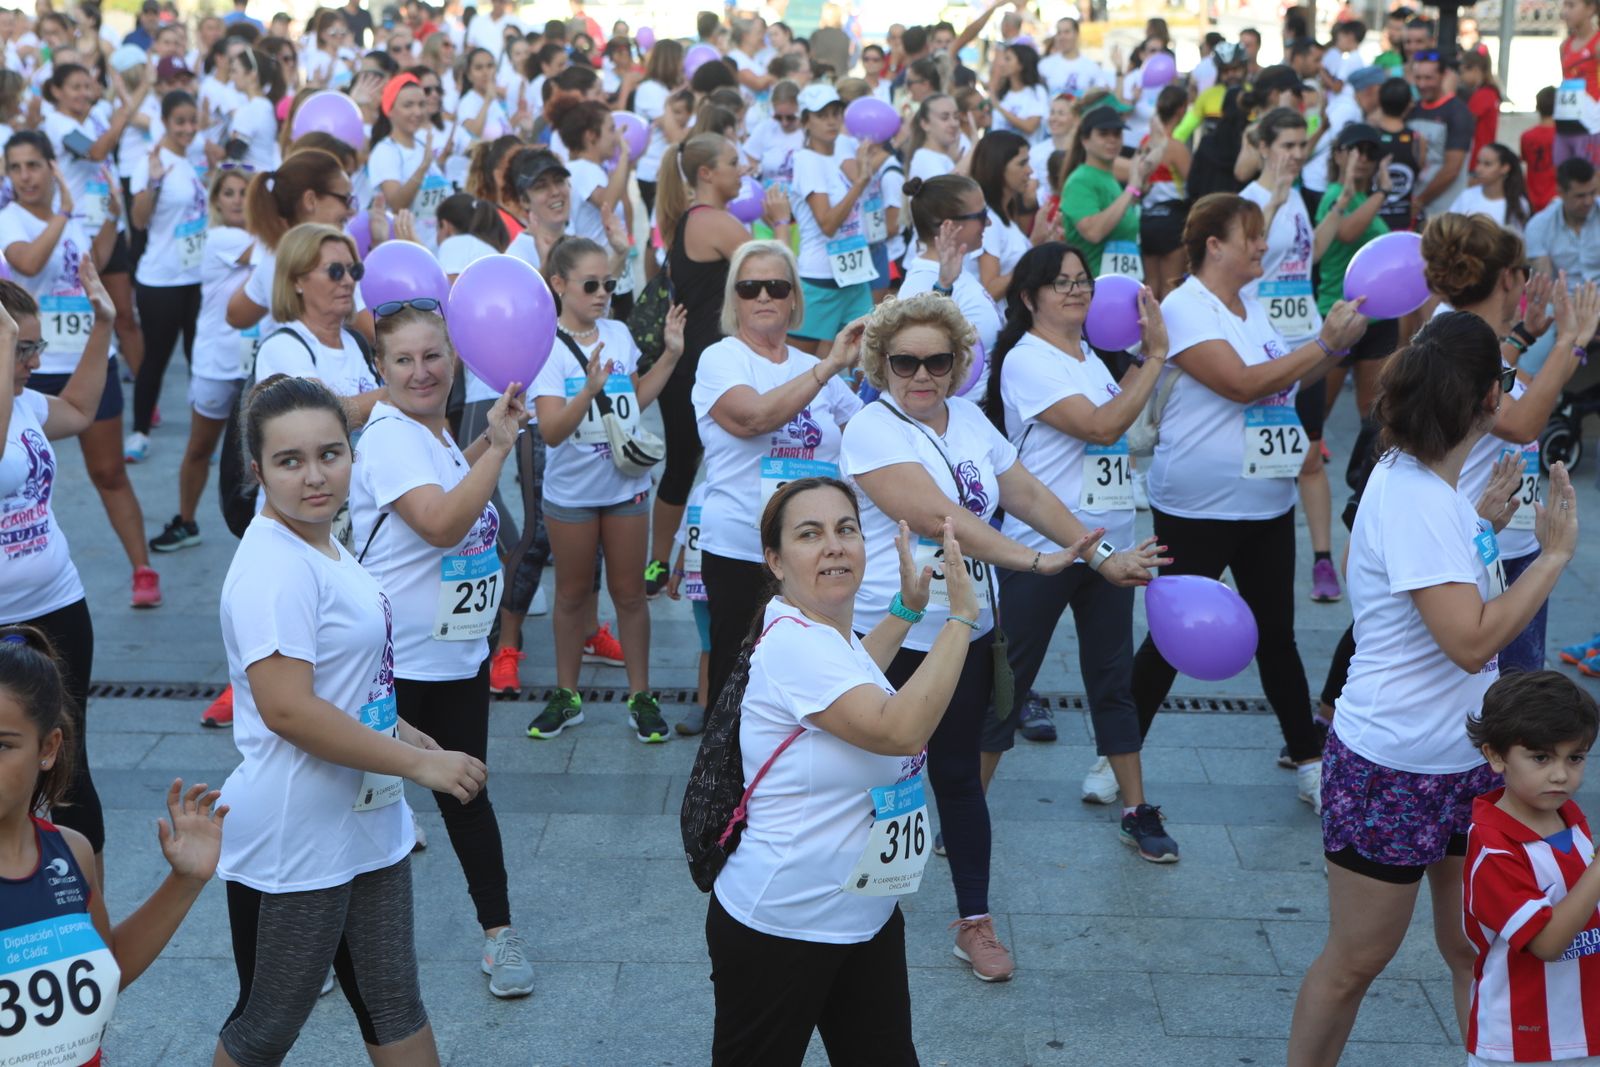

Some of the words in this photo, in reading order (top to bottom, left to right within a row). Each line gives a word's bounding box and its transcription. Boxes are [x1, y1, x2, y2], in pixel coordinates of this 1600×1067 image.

[837, 250, 863, 272] 337
[1111, 254, 1138, 273] 184
[1270, 297, 1308, 318] 506
[52, 314, 92, 335] 193
[588, 395, 630, 422] 10
[1259, 427, 1302, 456] 312
[1097, 456, 1132, 487] 314
[452, 575, 497, 614] 237
[880, 811, 925, 864] 316
[4, 927, 54, 949] Diputación
[7, 952, 20, 964] de
[22, 945, 48, 960] Cádiz
[1585, 945, 1596, 955] OF
[0, 959, 101, 1037] 396
[8, 1048, 53, 1065] CARRERA
[54, 1044, 65, 1054] DE
[68, 1040, 77, 1050] LA
[78, 1032, 99, 1046] MUJER
[37, 1051, 77, 1067] CHICLANA
